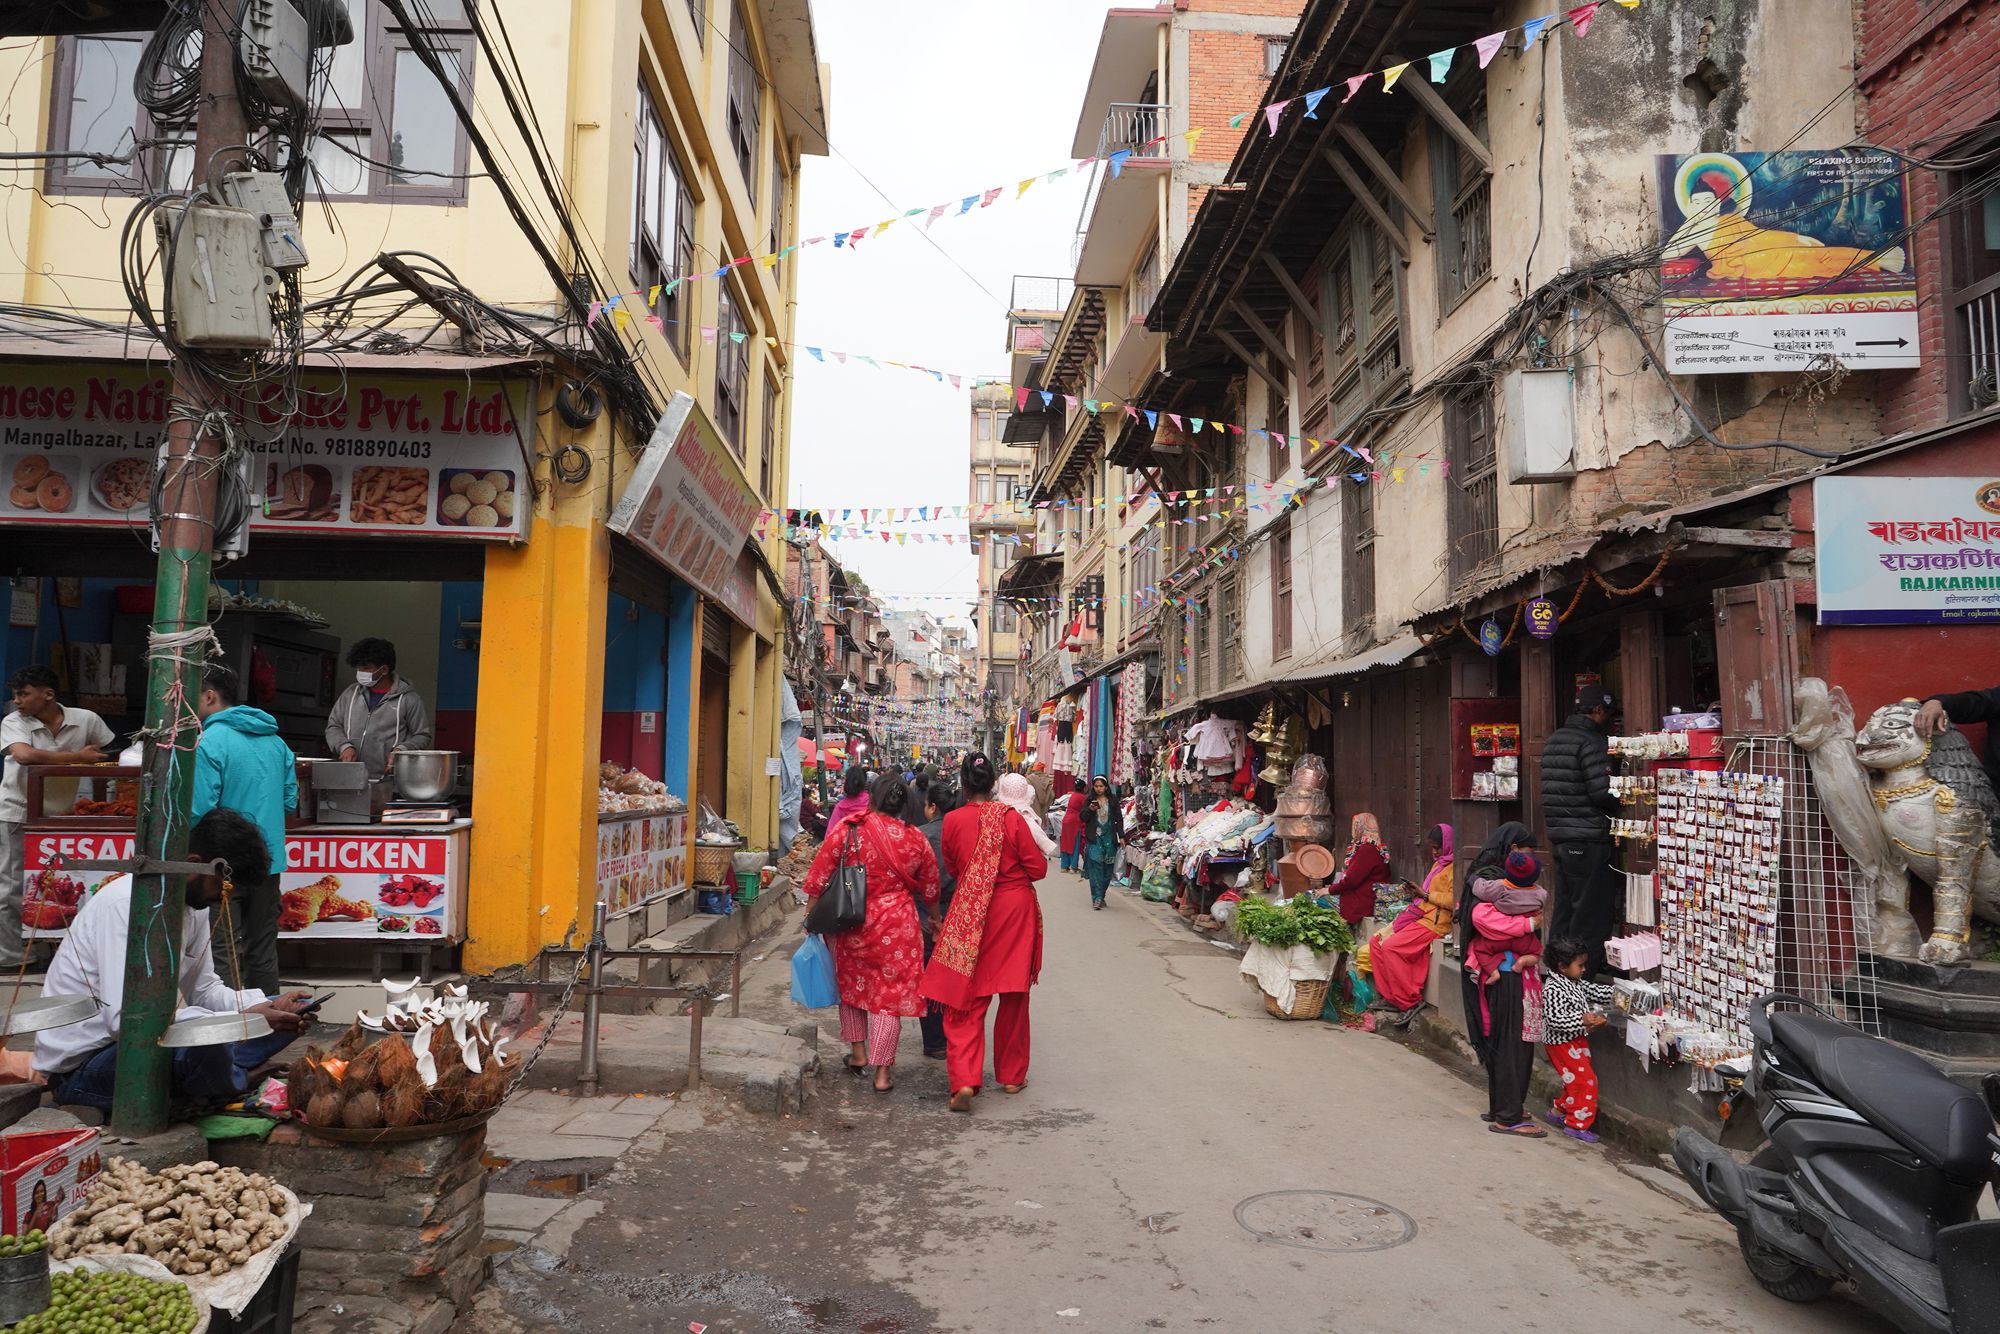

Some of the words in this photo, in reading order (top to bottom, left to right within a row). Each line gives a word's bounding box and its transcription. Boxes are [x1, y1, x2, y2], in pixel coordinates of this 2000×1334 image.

[357, 387, 430, 433] Pvt.
[440, 389, 513, 436] Ltd.
[4, 427, 127, 450] Mangalbazar,
[291, 437, 318, 455] No.
[325, 438, 431, 458] 9818890403
[1531, 609, 1553, 620] GO
[1942, 610, 1965, 618] Email:
[284, 841, 426, 869] CHICKEN
